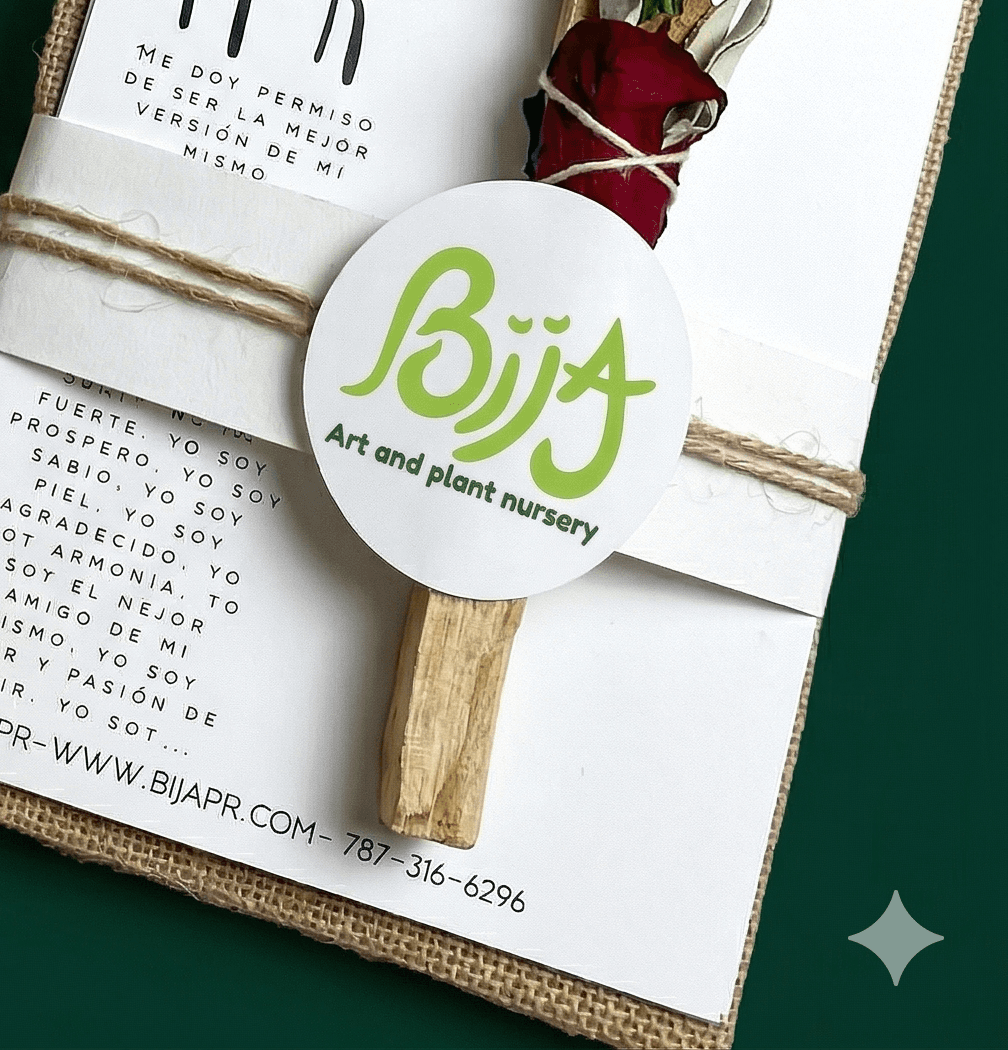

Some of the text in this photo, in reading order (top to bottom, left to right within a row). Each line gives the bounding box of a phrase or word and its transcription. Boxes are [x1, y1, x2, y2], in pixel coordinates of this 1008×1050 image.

[124, 70, 155, 92] DE
[172, 86, 218, 112] SER
[237, 106, 265, 127] LA
[136, 43, 373, 132] ME DOY PERMISO
[136, 101, 249, 148] VERSIÓN
[266, 143, 298, 165] DE
[183, 143, 265, 181] MISMO
[168, 432, 200, 456] YO
[217, 450, 267, 477] SOY
[144, 482, 175, 505] YO
[193, 501, 243, 527] SOY
[183, 466, 213, 488] YO
[231, 483, 281, 509] SOY
[324, 423, 599, 547] Art and plant nursery
[125, 507, 155, 528] YO
[173, 524, 223, 550] SOY
[4, 557, 56, 583] SOY
[70, 578, 98, 600] EL
[209, 564, 240, 586] YO
[4, 587, 188, 659] AMIGO DE MI
[208, 593, 239, 615] TO
[98, 647, 128, 668] YO
[146, 664, 197, 691] SOY
[38, 656, 50, 672] Y
[67, 667, 166, 712] PASIÓN
[184, 705, 218, 728] DE
[59, 697, 89, 720] YO
[342, 832, 526, 914] 787-316-6296
